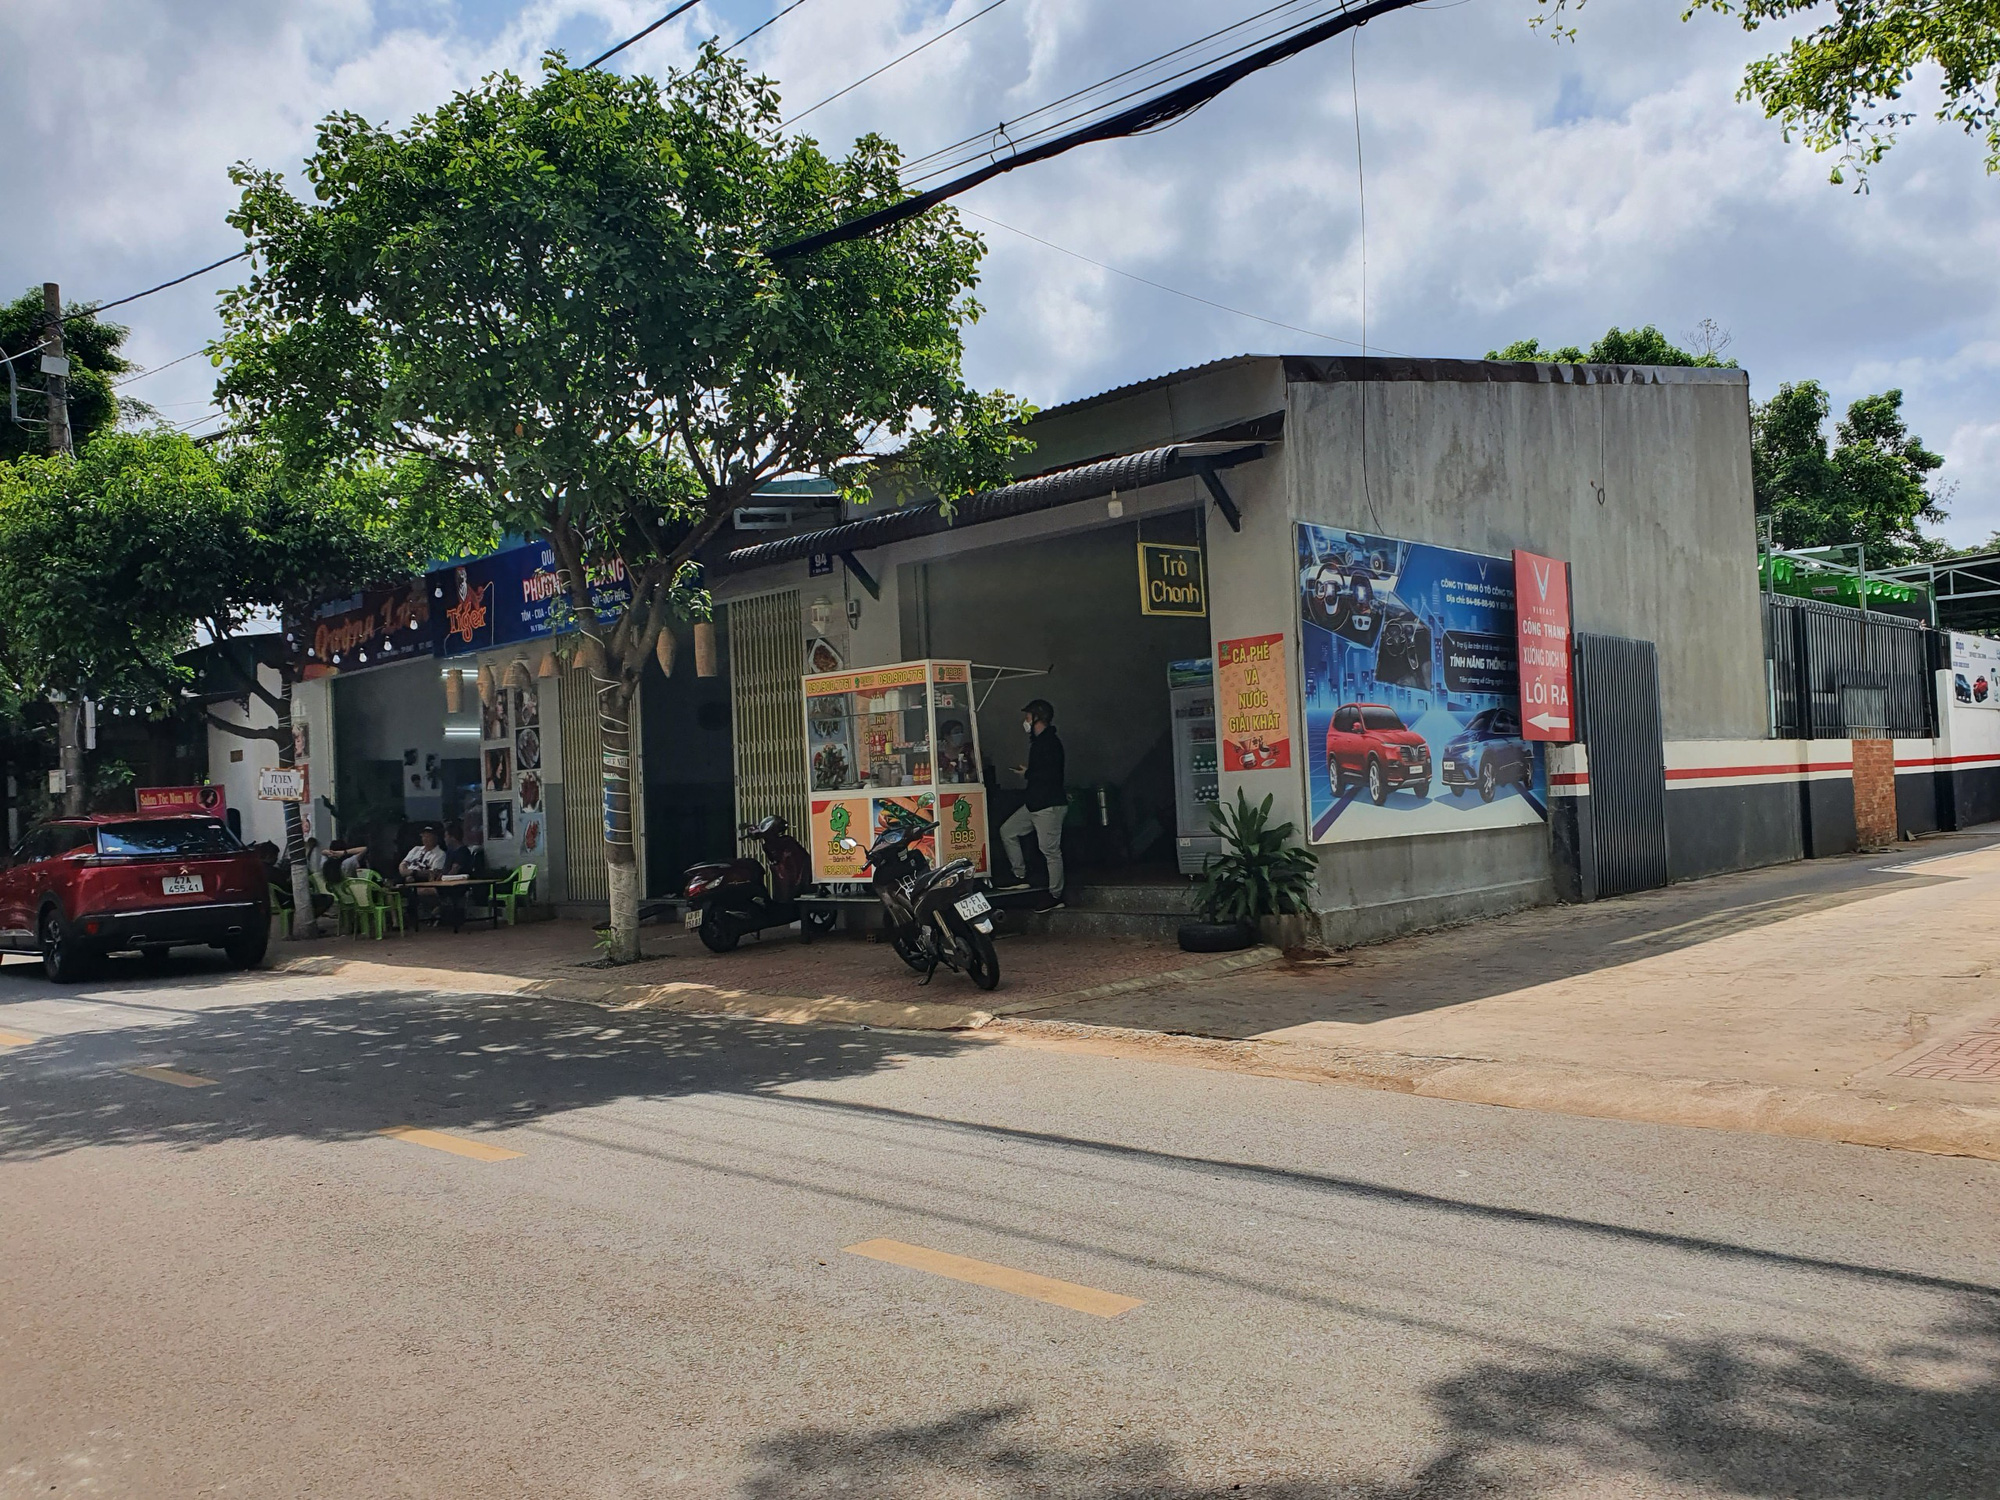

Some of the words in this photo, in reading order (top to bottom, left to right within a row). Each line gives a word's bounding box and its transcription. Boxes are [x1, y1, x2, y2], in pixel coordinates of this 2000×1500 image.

[814, 553, 827, 567] 94
[1151, 580, 1199, 604] Chanh
[1440, 578, 1457, 590] CÔNG
[1457, 582, 1463, 590] TY
[446, 601, 487, 643] Tiger
[1523, 617, 1541, 637] CÔNG
[1543, 620, 1566, 641] THÀNH
[1232, 644, 1247, 664] CÀ
[1250, 641, 1270, 662] PHÊ
[1450, 653, 1465, 668] TÍNH
[1466, 655, 1485, 669] NĂNG
[1486, 657, 1506, 670] THÔNG
[1523, 641, 1544, 666] XƯỞNG
[1545, 650, 1559, 671] DỊCH
[807, 678, 851, 693] 090.900.7761
[878, 669, 925, 685] 090.900.7761
[945, 667, 962, 677] 1988
[1244, 664, 1260, 685] VÀ
[1238, 688, 1268, 709] NƯỚC
[1525, 675, 1547, 704] LỐI
[1551, 684, 1569, 706] RA
[1229, 712, 1250, 733] GIẢI
[1253, 710, 1280, 732] KHÁT
[140, 794, 156, 806] Salon
[169, 792, 183, 804] Nam
[263, 785, 282, 796] NHÂN
[282, 785, 299, 797] VIÊN
[950, 829, 976, 844] 1988
[169, 884, 199, 893] 455.41
[175, 876, 191, 885] 47A
[962, 902, 989, 918] 424.98
